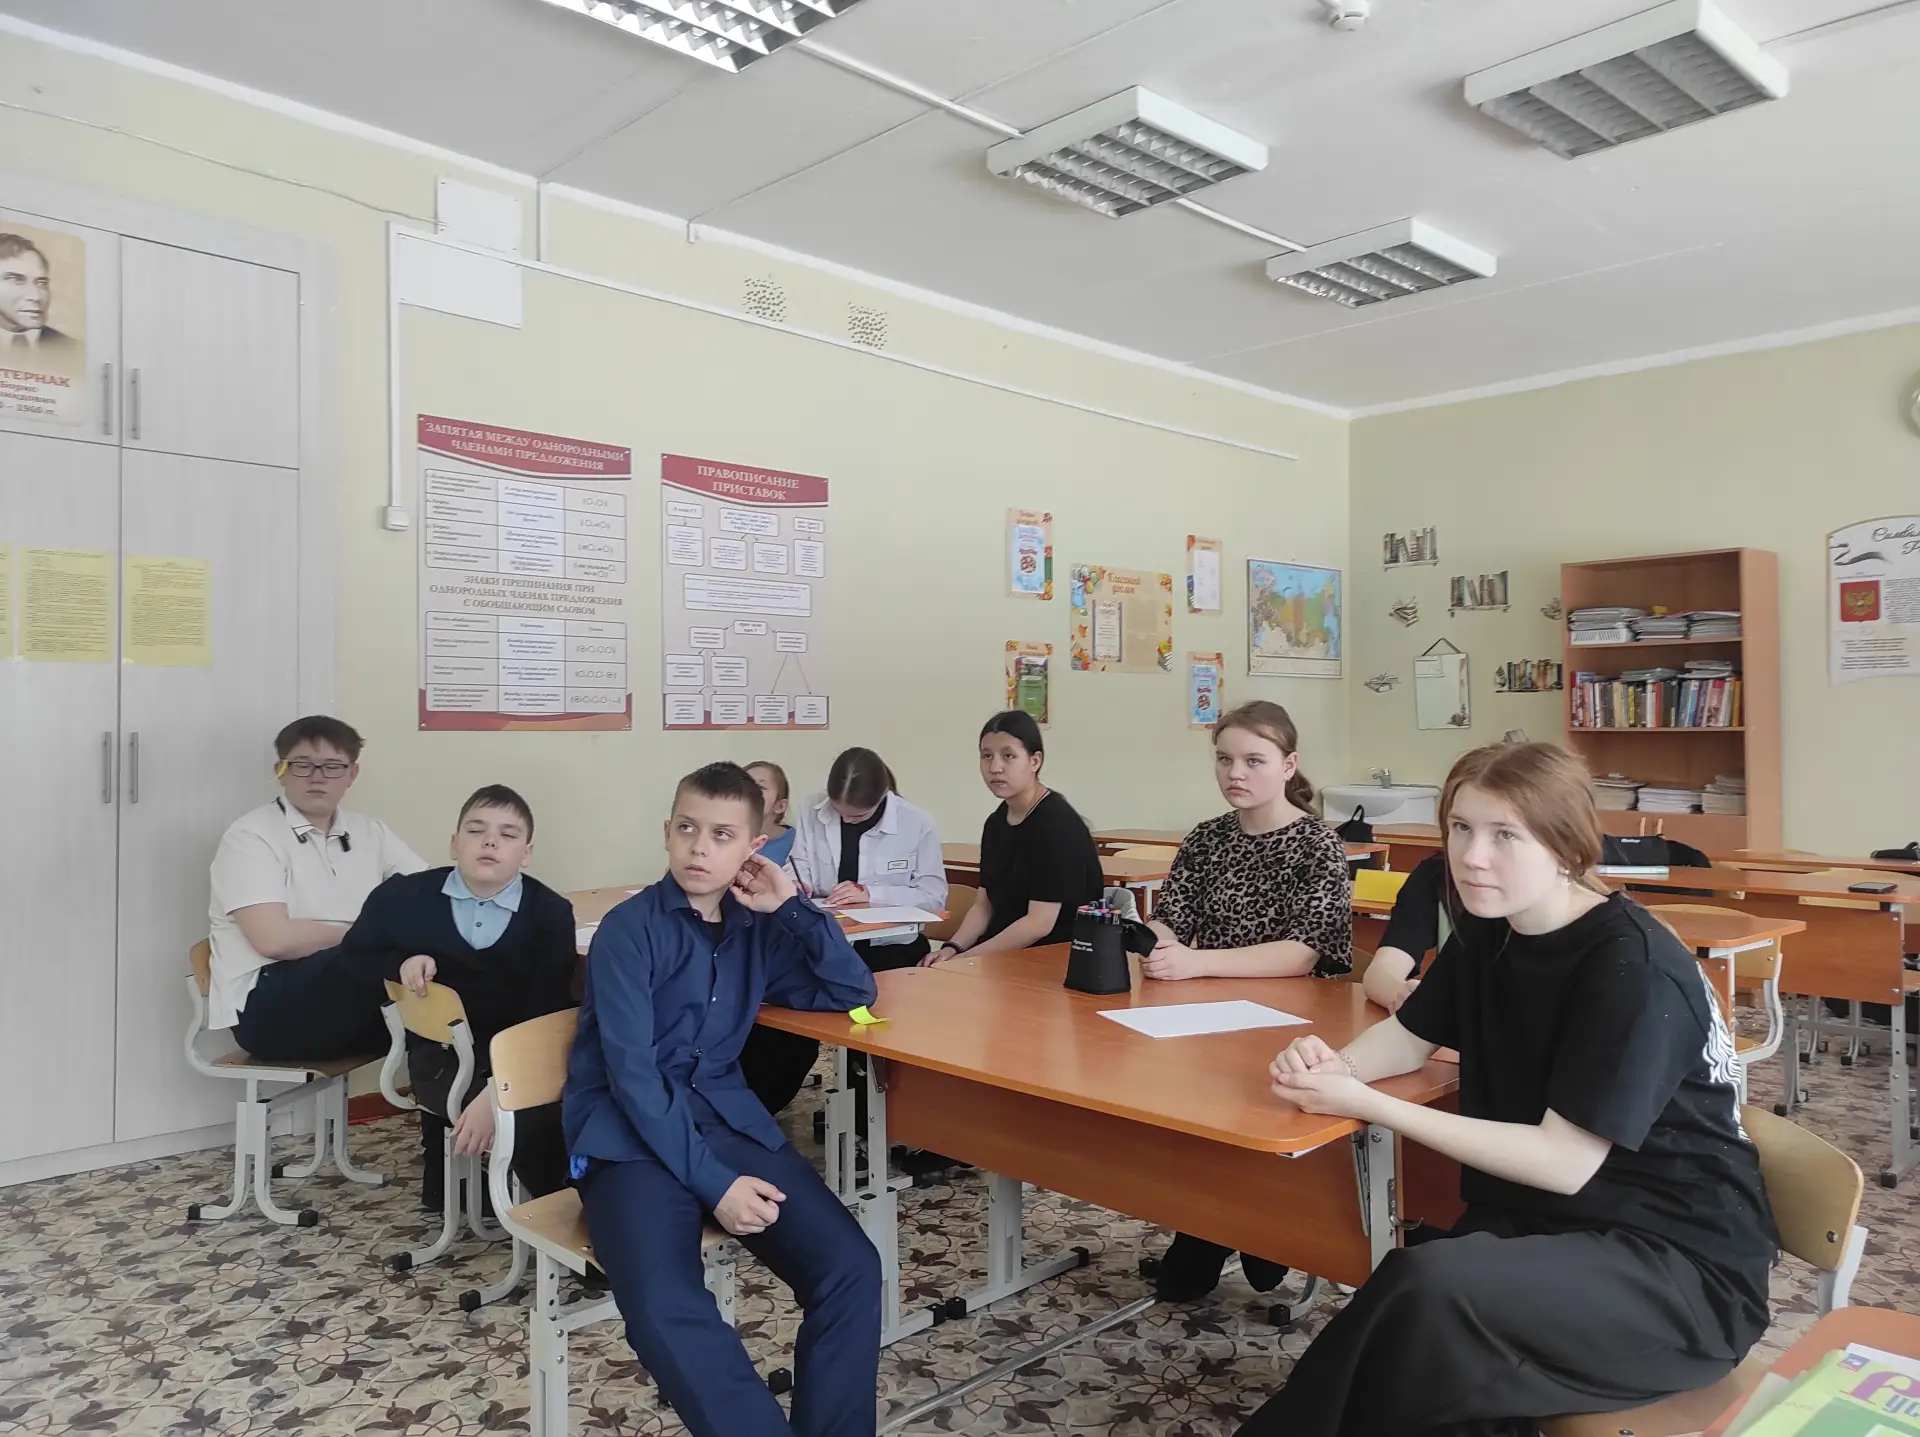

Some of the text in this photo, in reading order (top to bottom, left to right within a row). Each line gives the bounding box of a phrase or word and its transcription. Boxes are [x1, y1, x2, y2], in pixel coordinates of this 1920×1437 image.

[425, 422, 624, 462] ЗАПЯТАЯ МЕЖДУ ОДНОРОДНЫМИ
[451, 439, 604, 471] ЧЛЕНАМИ ПРЕДЛОЖЕНИЯ
[697, 465, 800, 489] ПРАВОПИСАНИЕ
[713, 481, 787, 501] ПРИСТАВОК
[429, 584, 624, 606] ОДНОРОДНЫХ ЧЛЕНАХ ПРЕДЛОЖЕНИЯ
[463, 575, 595, 593] ЗНАКИ ПРЕПИНАНИЯ ПРИ
[463, 599, 596, 615] С ОБОБЩАЮЩИМ СЛОВОМ
